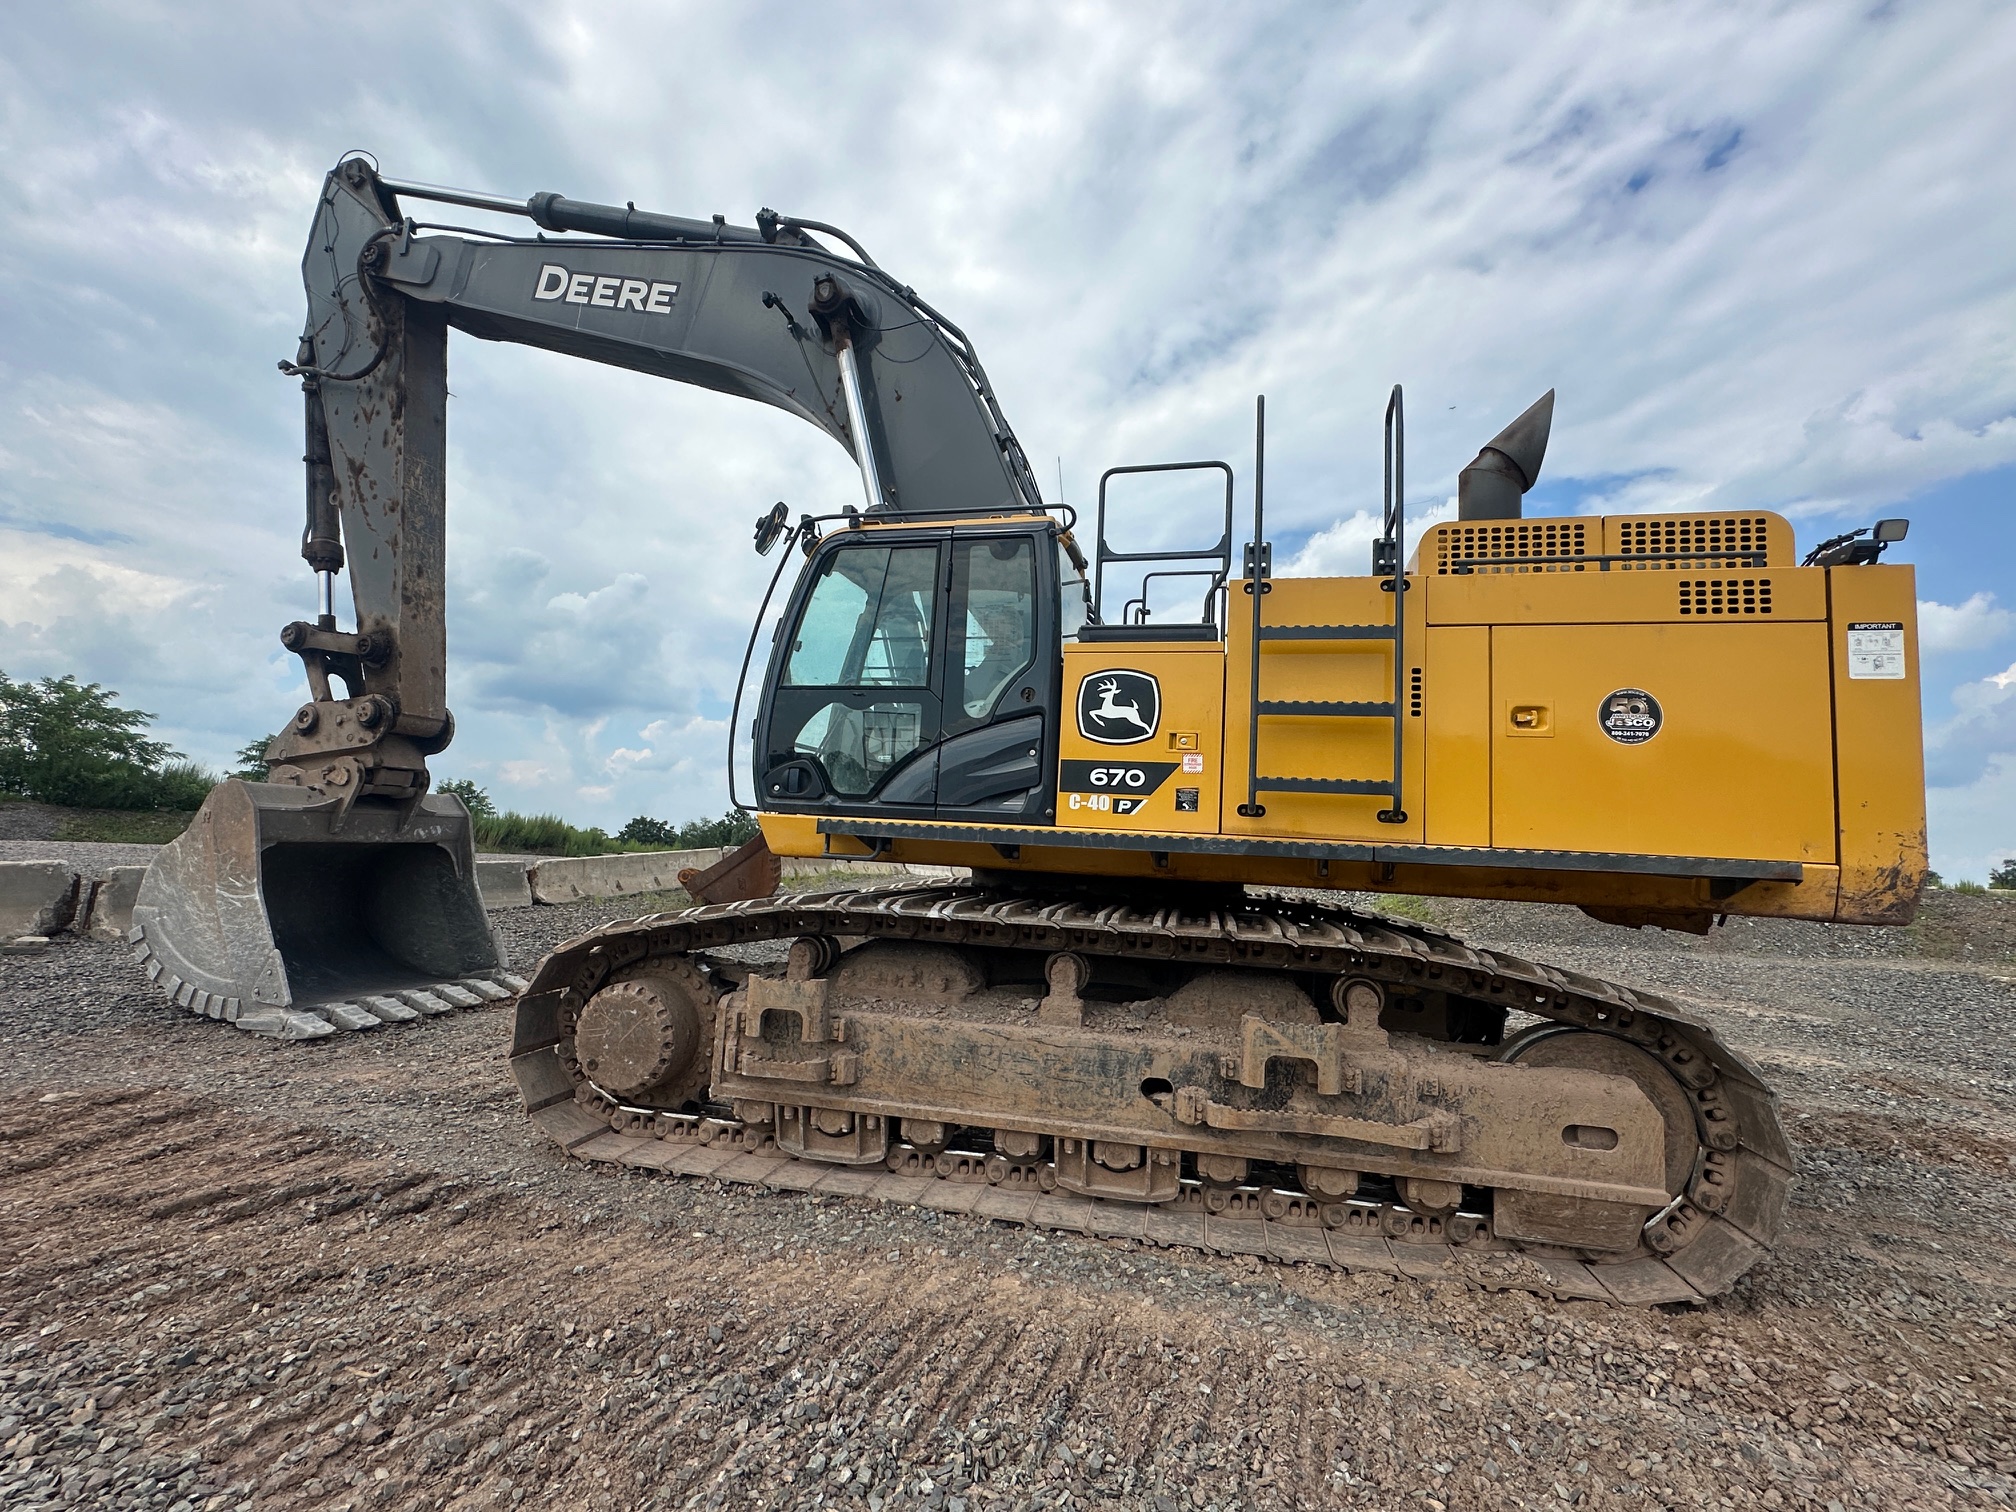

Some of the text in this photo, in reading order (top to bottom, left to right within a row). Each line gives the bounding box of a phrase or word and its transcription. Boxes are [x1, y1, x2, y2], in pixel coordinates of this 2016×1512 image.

[534, 264, 678, 314] DEERE
[1606, 717, 1654, 727] JESCO
[1089, 768, 1146, 787] 670
[1068, 793, 1132, 813] C-40 P
